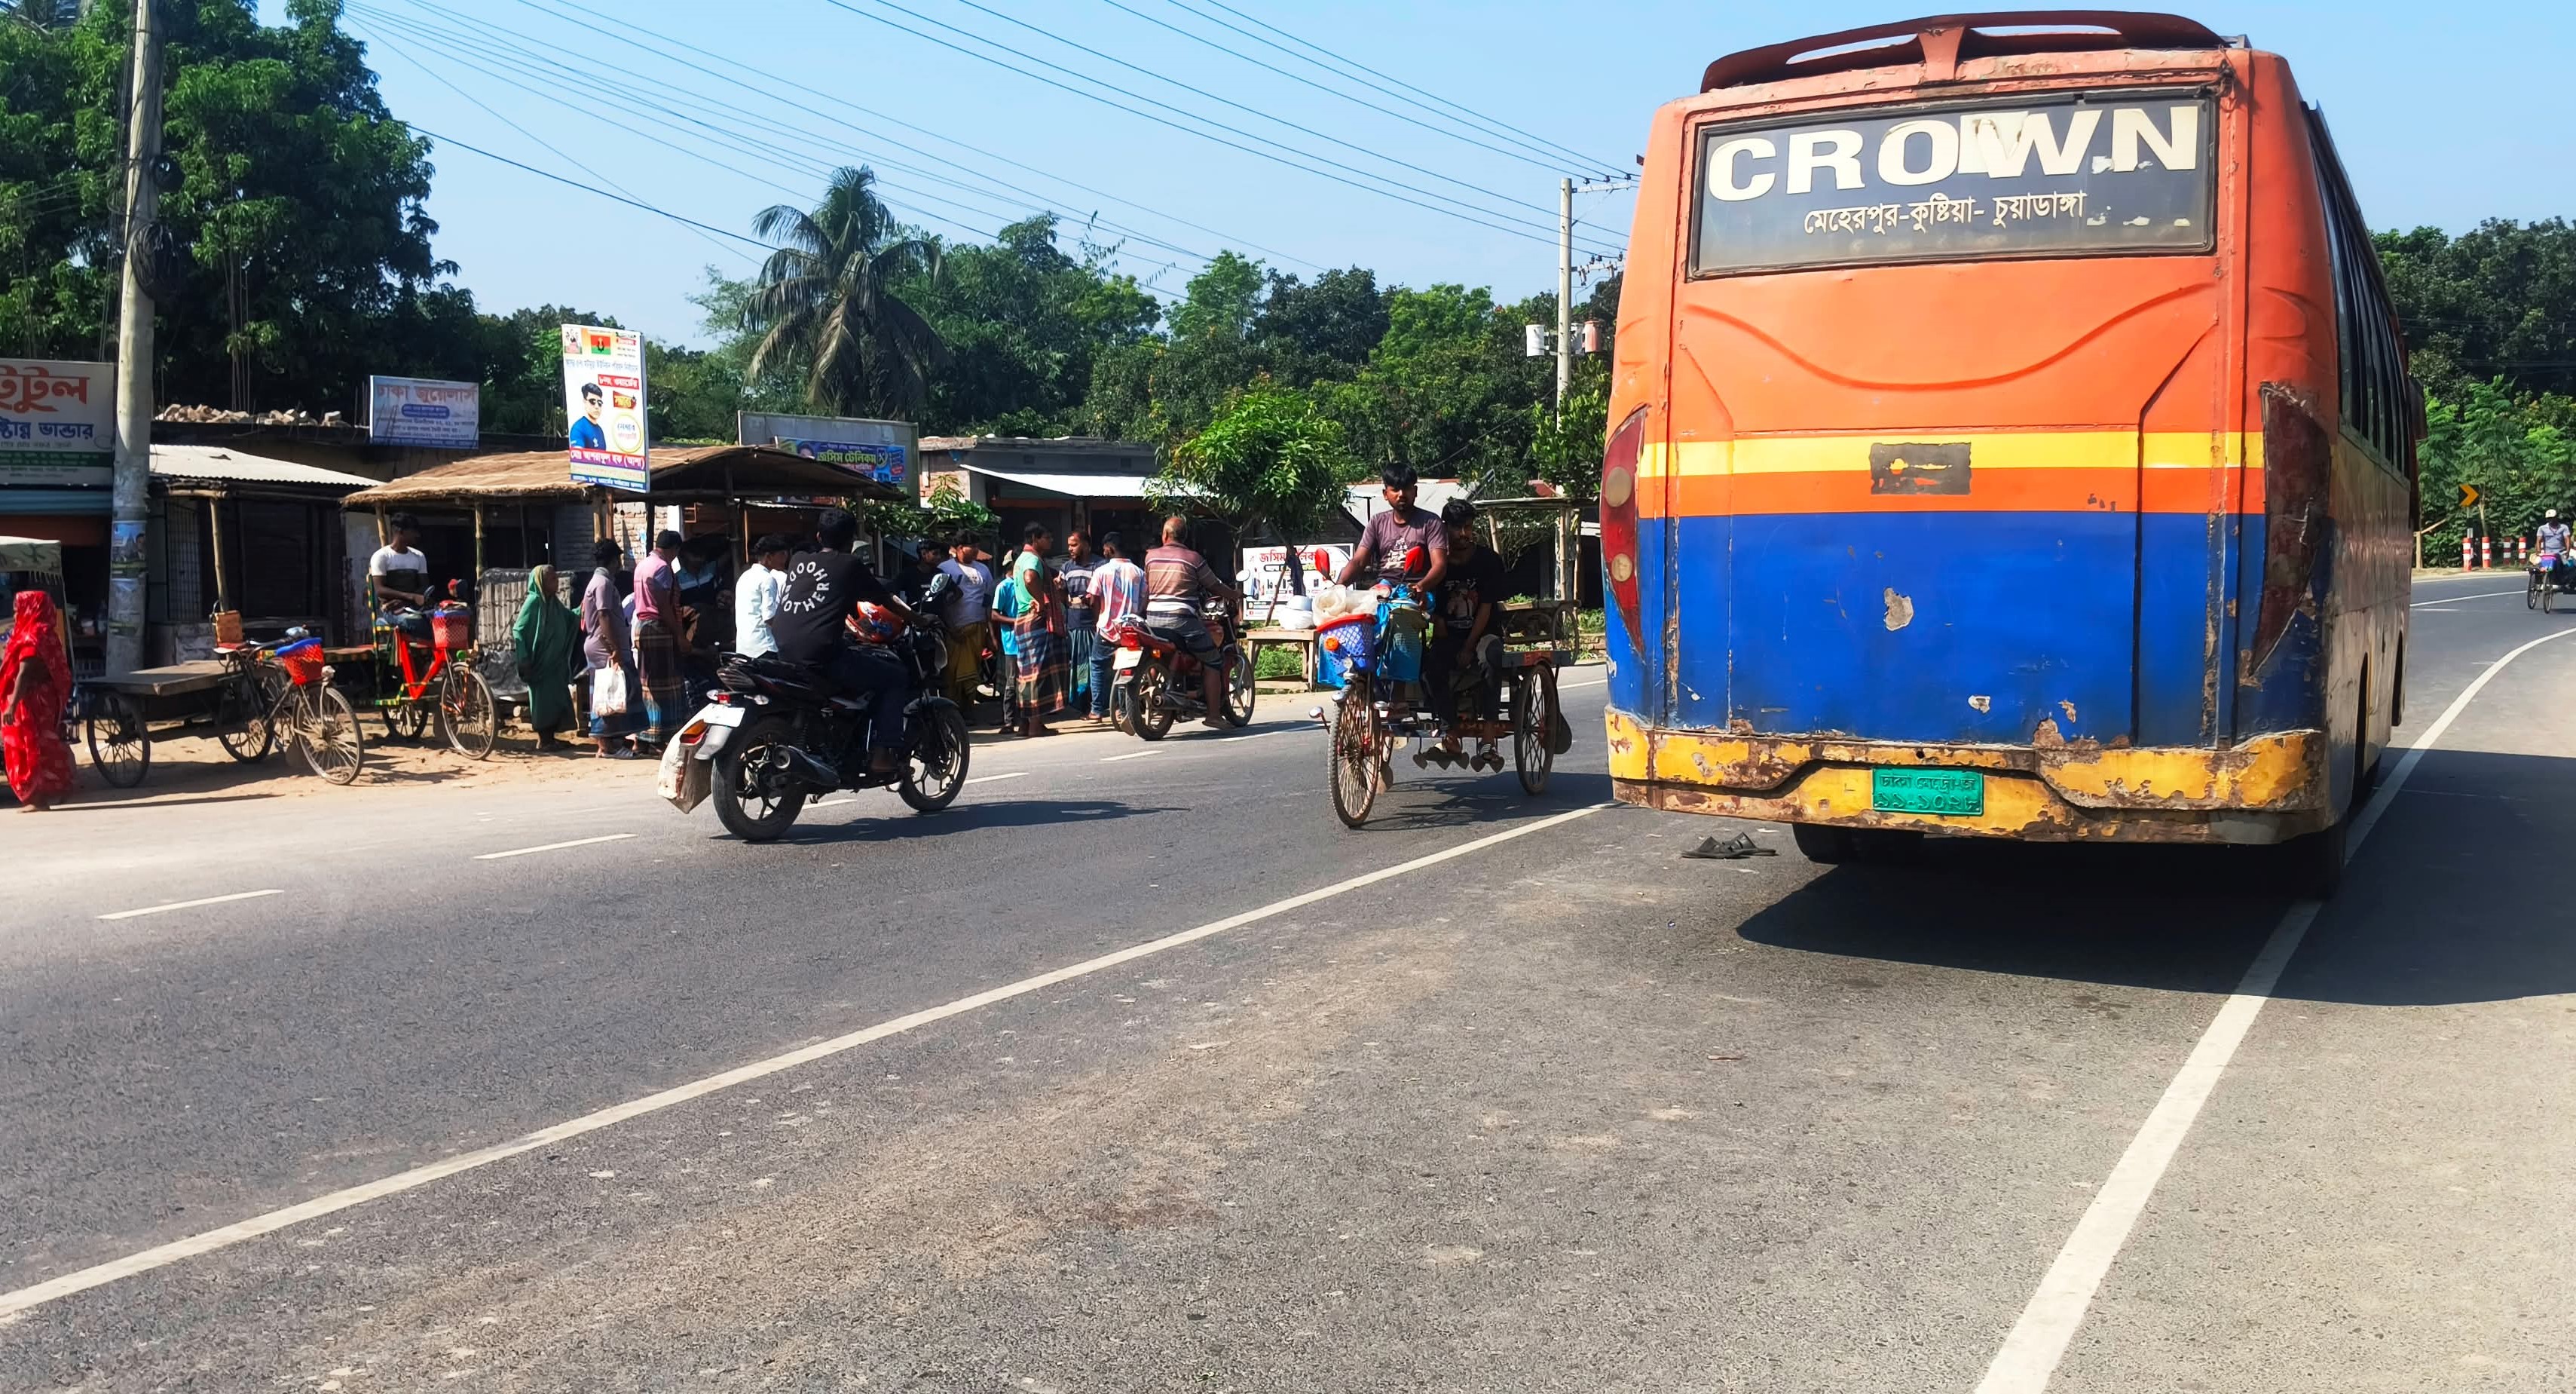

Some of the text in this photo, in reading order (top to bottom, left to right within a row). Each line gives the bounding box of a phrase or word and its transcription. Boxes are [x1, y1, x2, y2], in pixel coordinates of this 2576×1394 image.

[1707, 106, 2199, 202] CROWN
[1993, 189, 2088, 228] চুয়াডাঙ্গা
[377, 385, 410, 400] ঢাকা
[38, 423, 93, 440] ভান্ডার
[817, 449, 843, 462] জসিম
[844, 450, 877, 464] টেলিকম
[1879, 772, 1912, 788] ঢাকা
